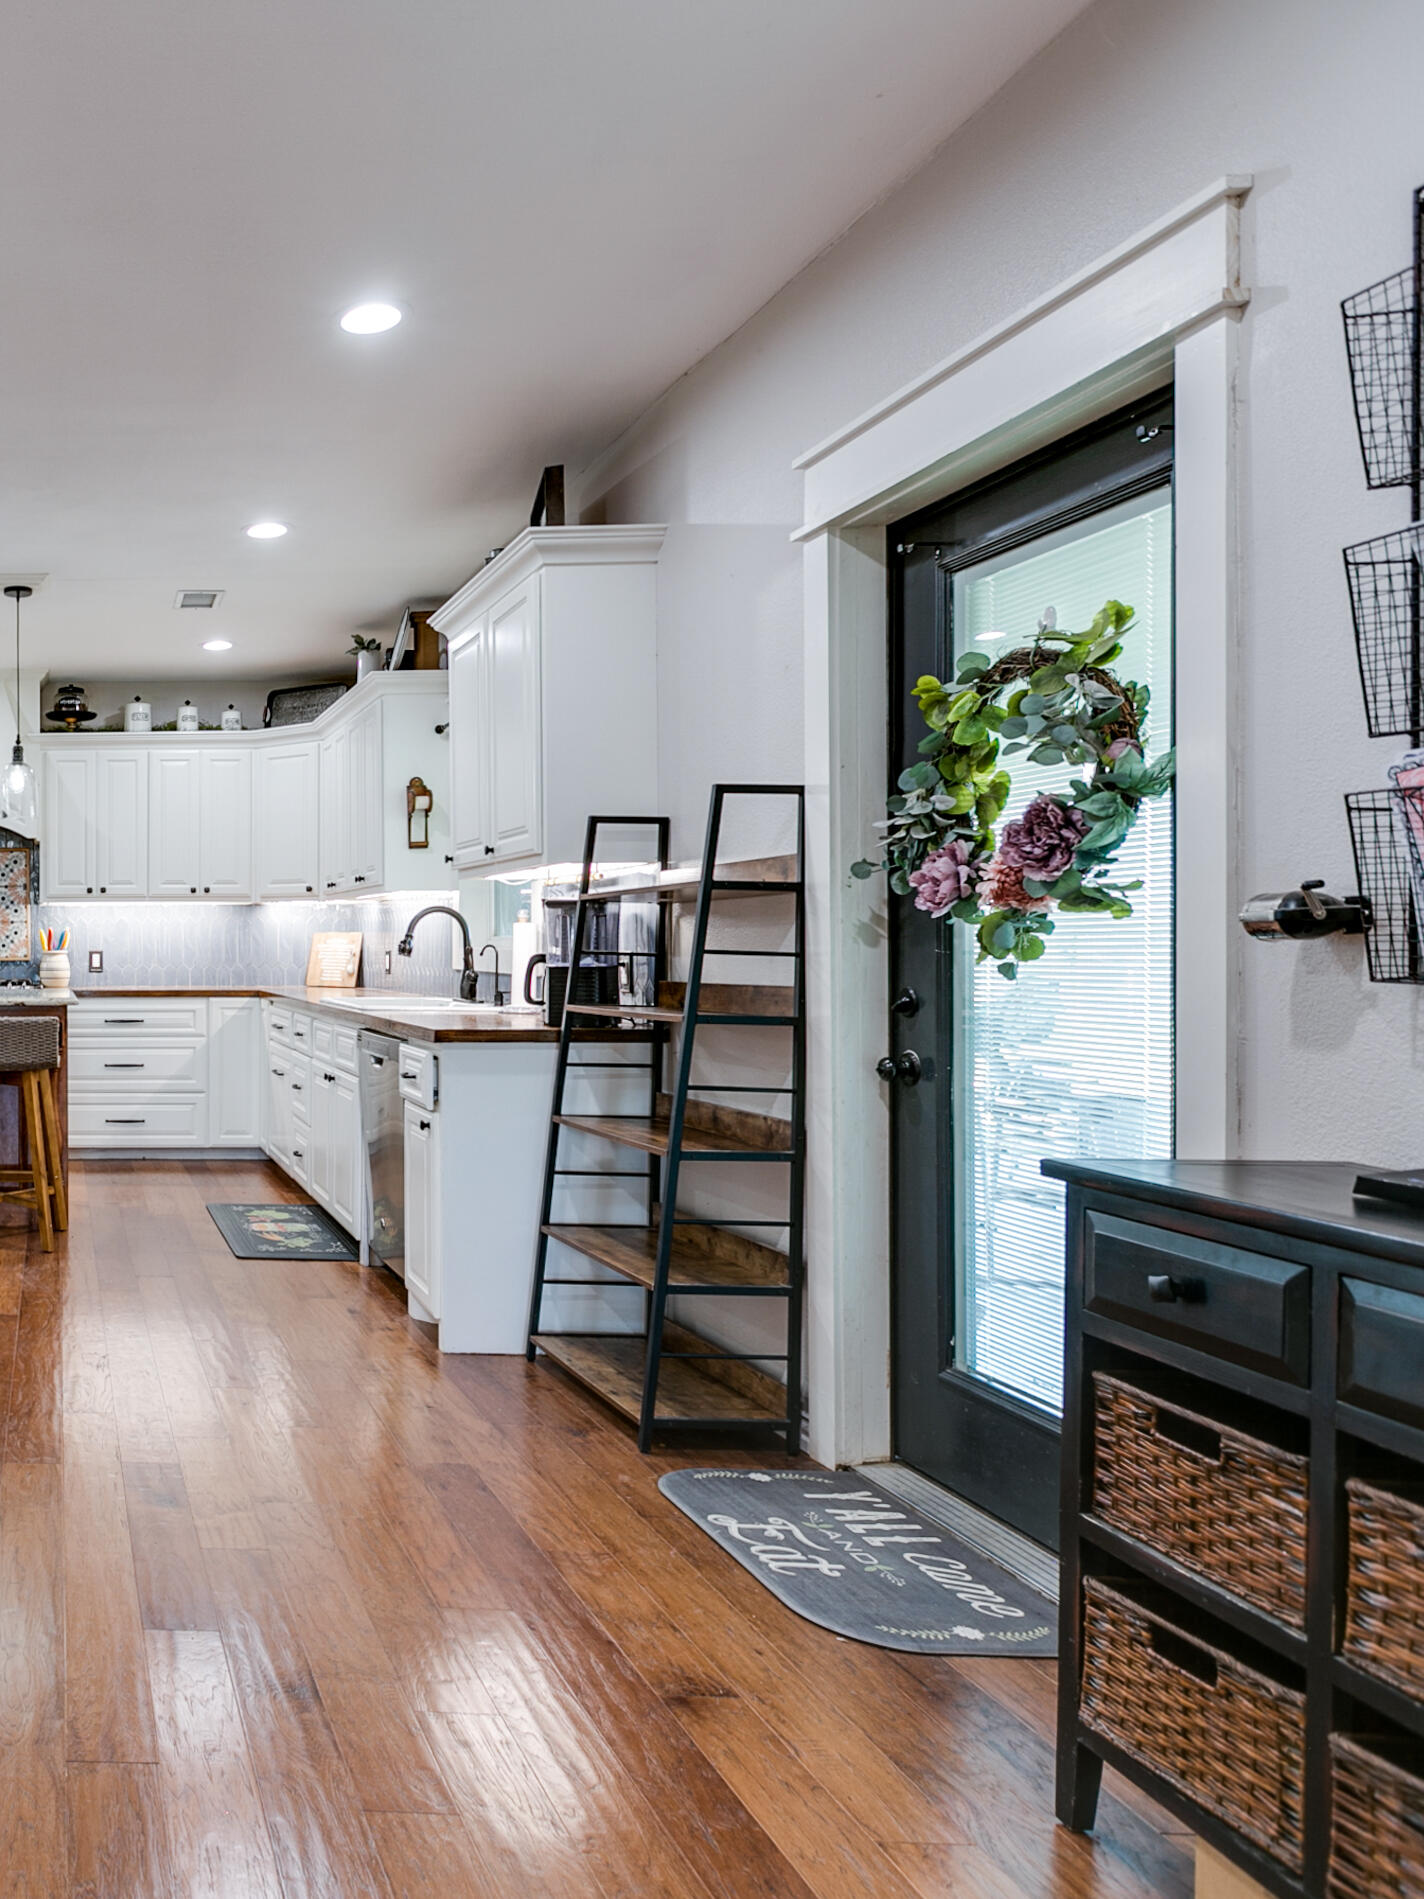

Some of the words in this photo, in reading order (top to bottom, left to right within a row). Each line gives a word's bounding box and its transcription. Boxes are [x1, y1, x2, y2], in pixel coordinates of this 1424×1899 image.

[707, 1514, 846, 1577] Eat
[803, 1491, 942, 1547] Y'ALL
[818, 1528, 879, 1564] AND
